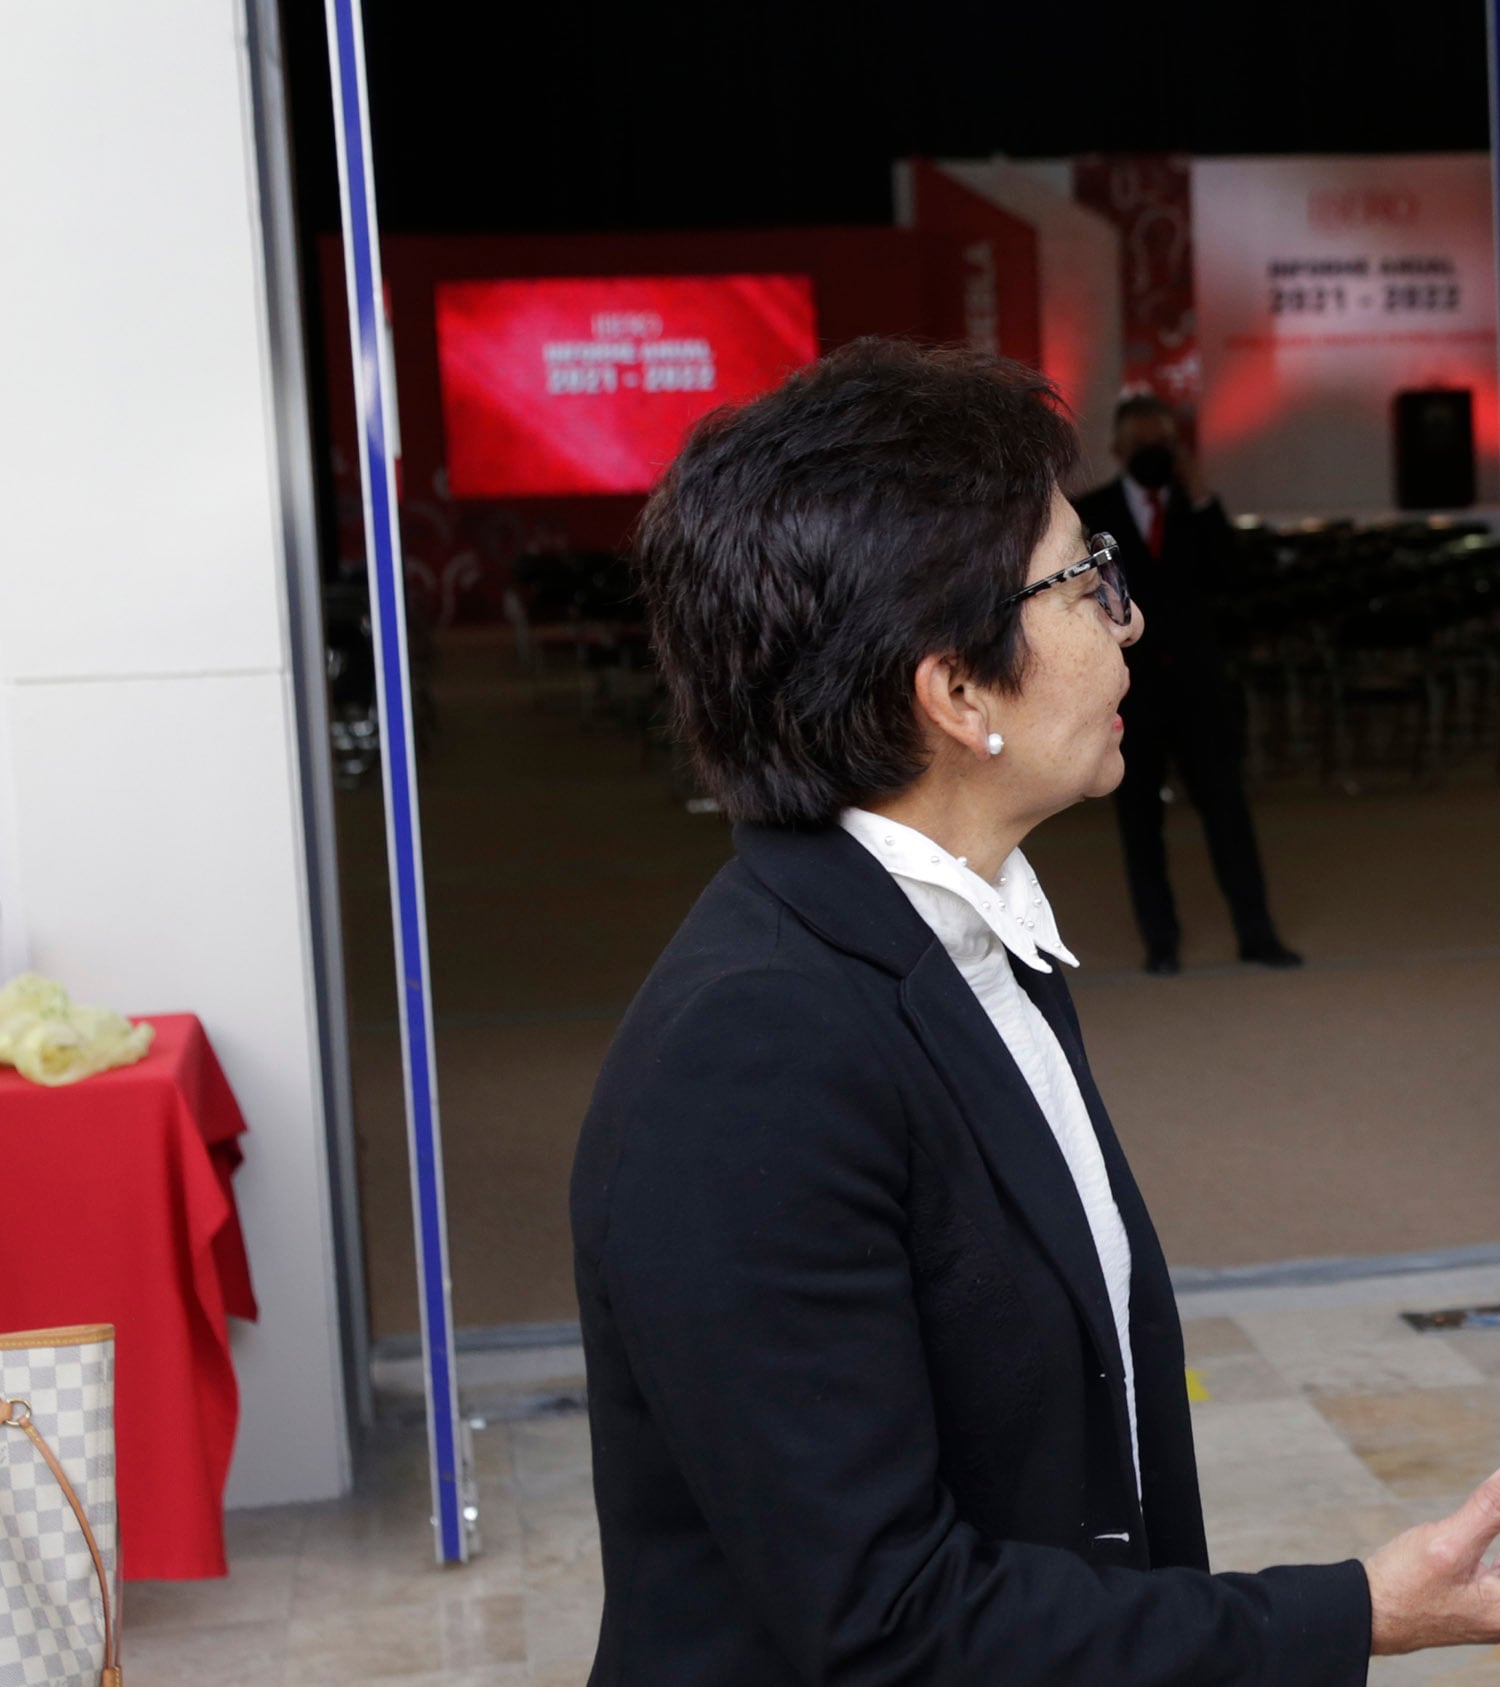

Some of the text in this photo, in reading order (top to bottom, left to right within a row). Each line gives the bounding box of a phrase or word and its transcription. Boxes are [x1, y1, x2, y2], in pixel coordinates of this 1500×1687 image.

[1271, 286, 1345, 314] 2021
[1385, 283, 1460, 313] 2022
[548, 365, 618, 394] 2021
[643, 363, 716, 392] 2022
